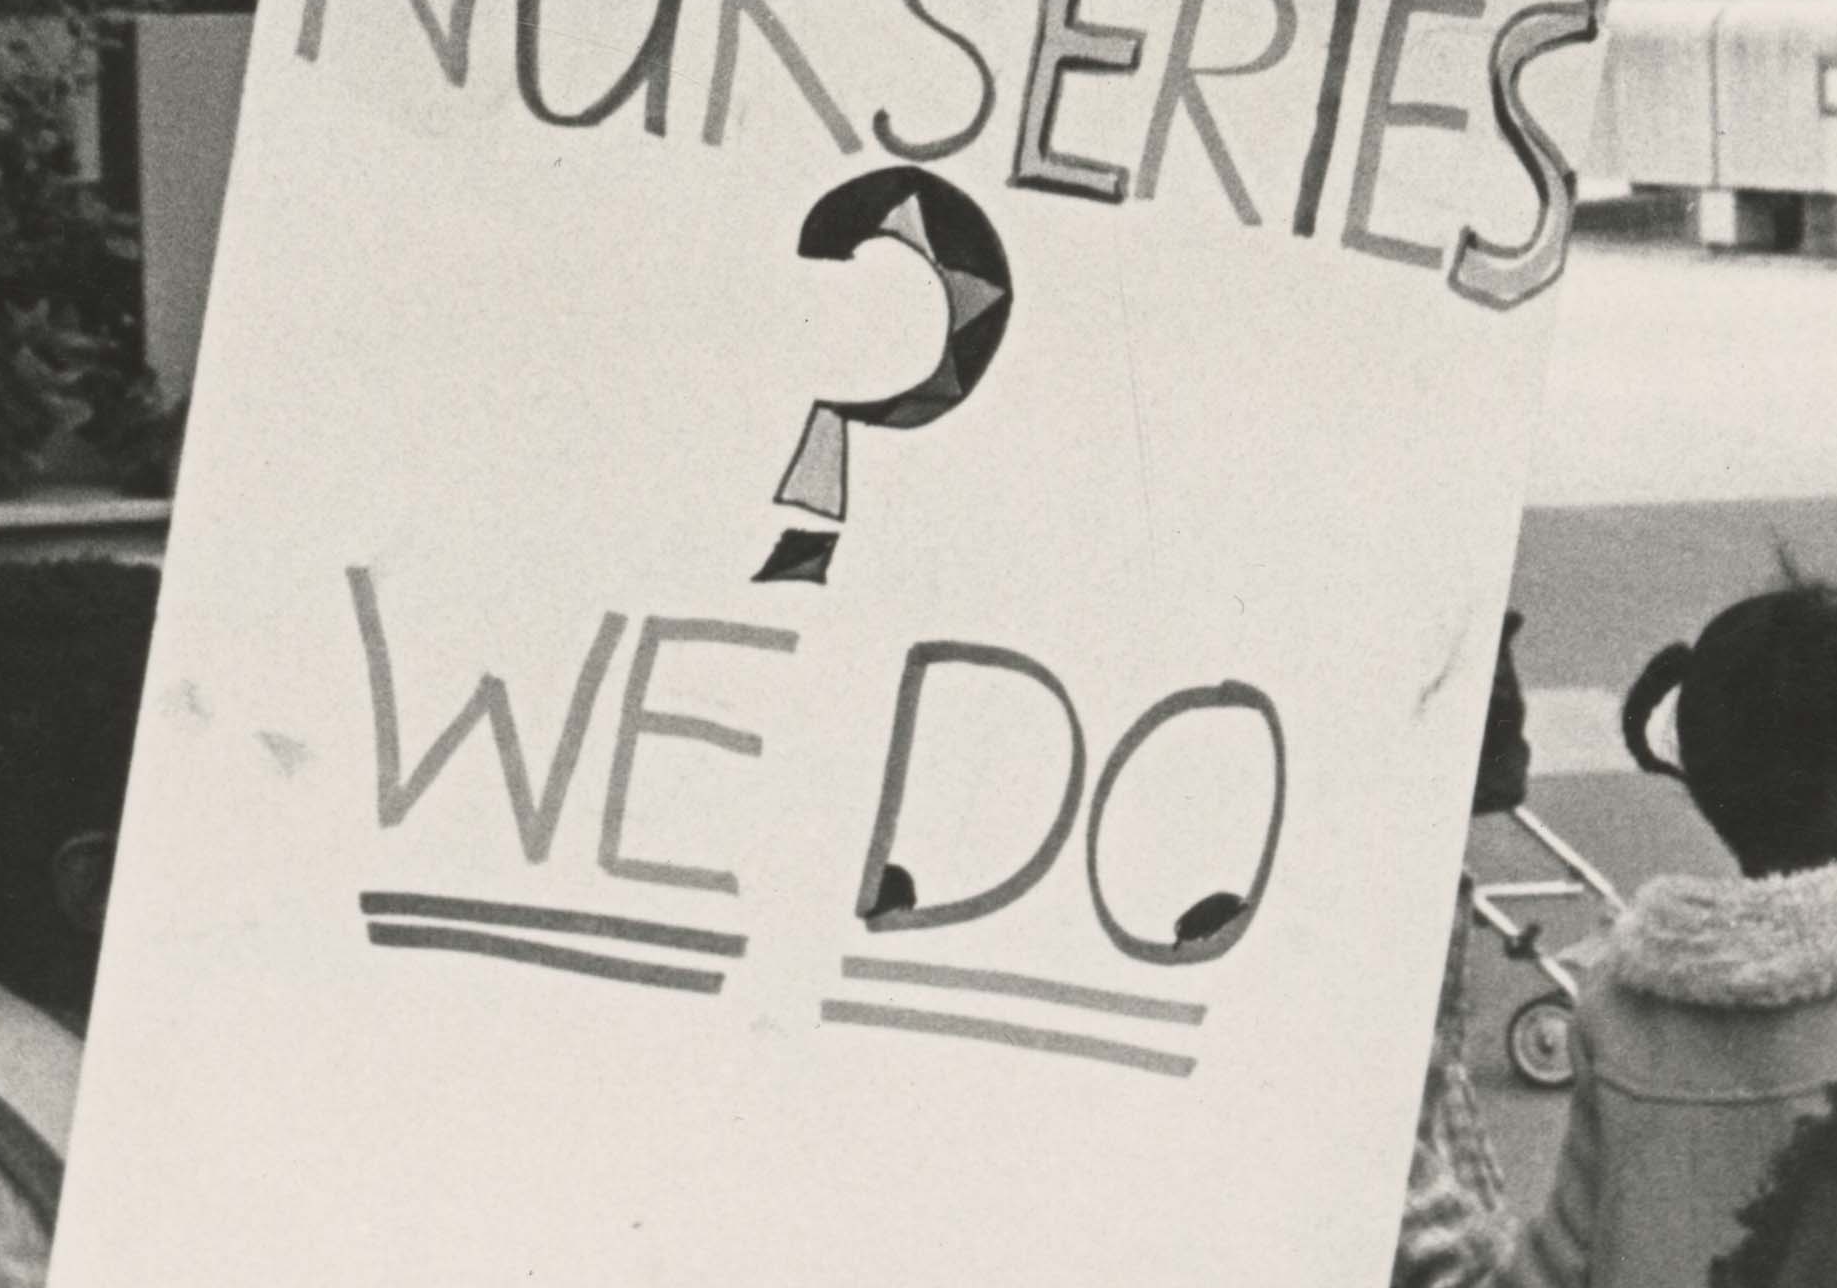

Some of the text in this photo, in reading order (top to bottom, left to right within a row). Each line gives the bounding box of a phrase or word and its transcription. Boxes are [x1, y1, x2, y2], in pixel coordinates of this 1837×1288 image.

[752, 164, 1014, 585] ?
[347, 565, 1288, 967] WE DO
